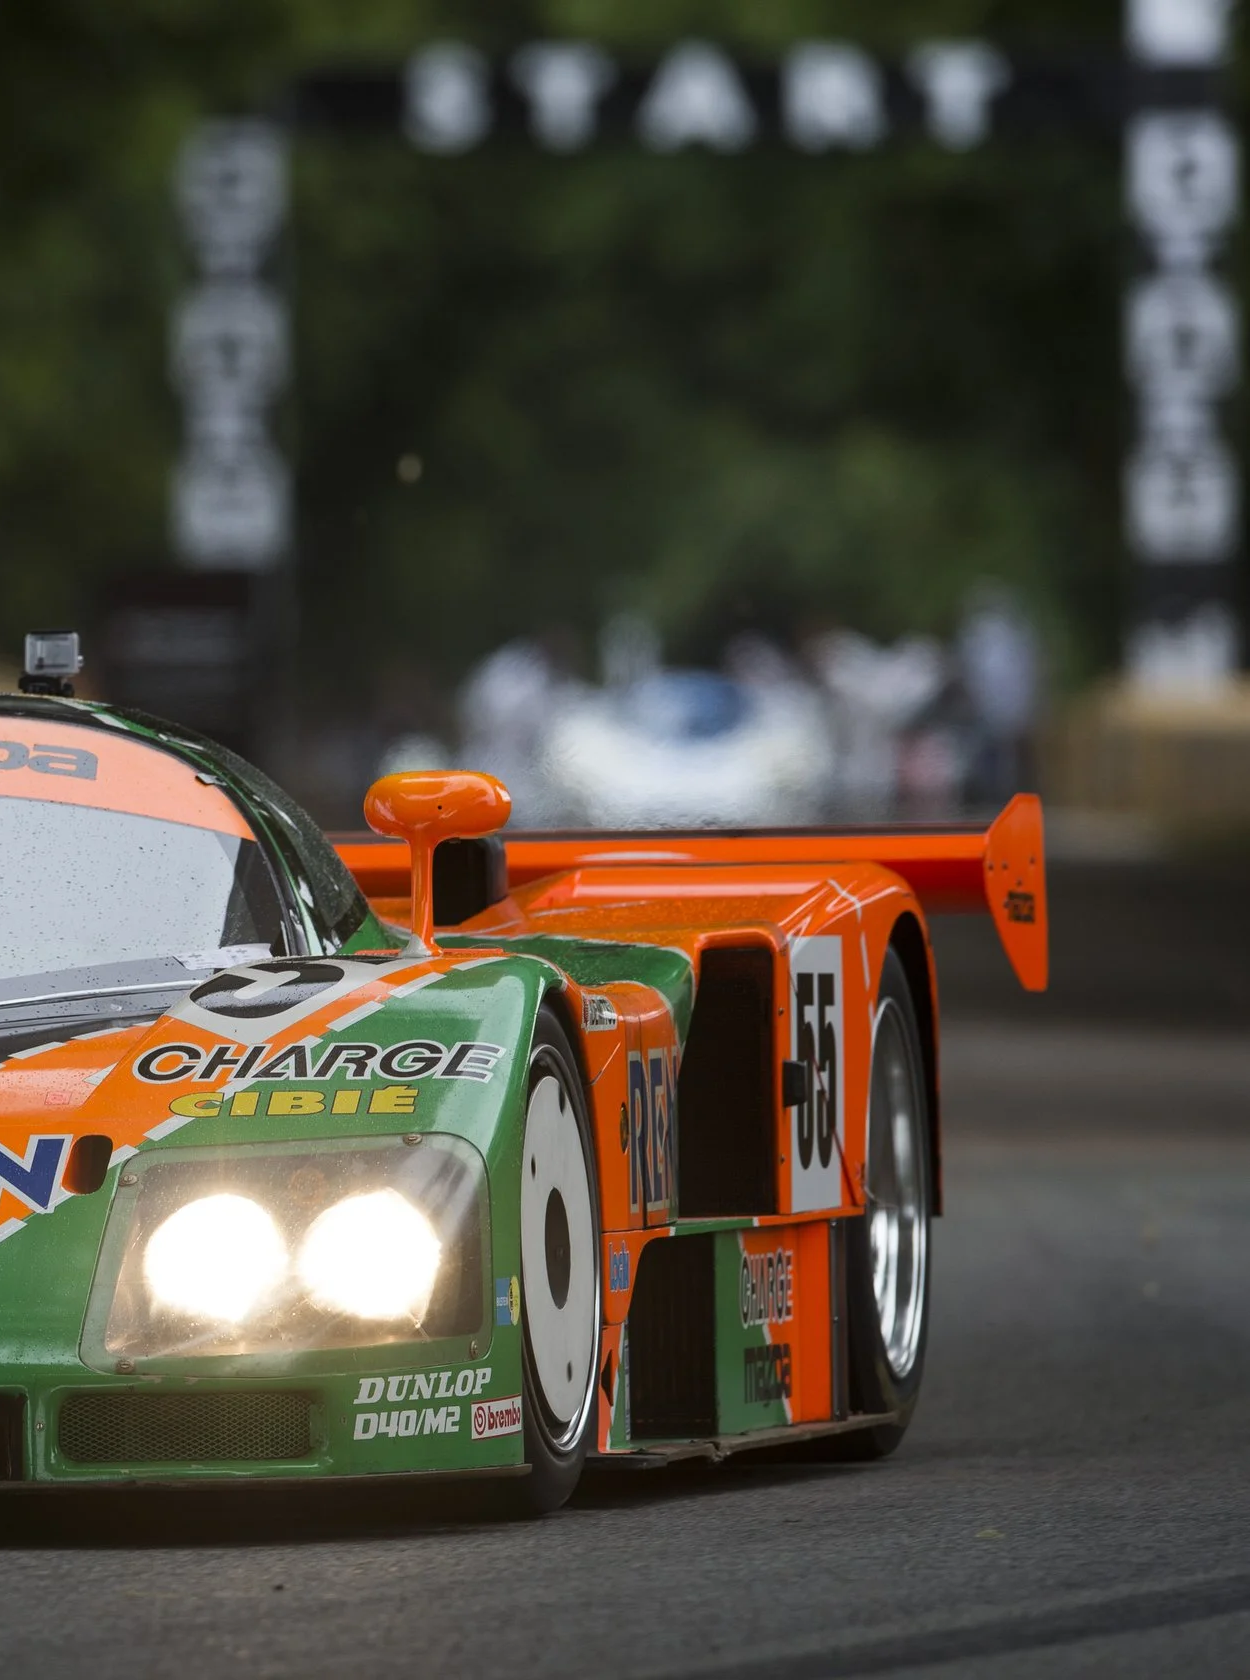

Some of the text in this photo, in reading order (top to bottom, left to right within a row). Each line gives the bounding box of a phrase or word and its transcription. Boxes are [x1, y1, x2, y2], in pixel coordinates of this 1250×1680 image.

[405, 42, 1008, 154] START
[131, 1039, 507, 1084] CHARGE
[796, 972, 837, 1170] 55
[168, 1085, 420, 1118] CIBIÉ
[353, 1367, 491, 1404] DUNLOP
[354, 1406, 460, 1440] D40/M2
[487, 1401, 521, 1431] brembo
